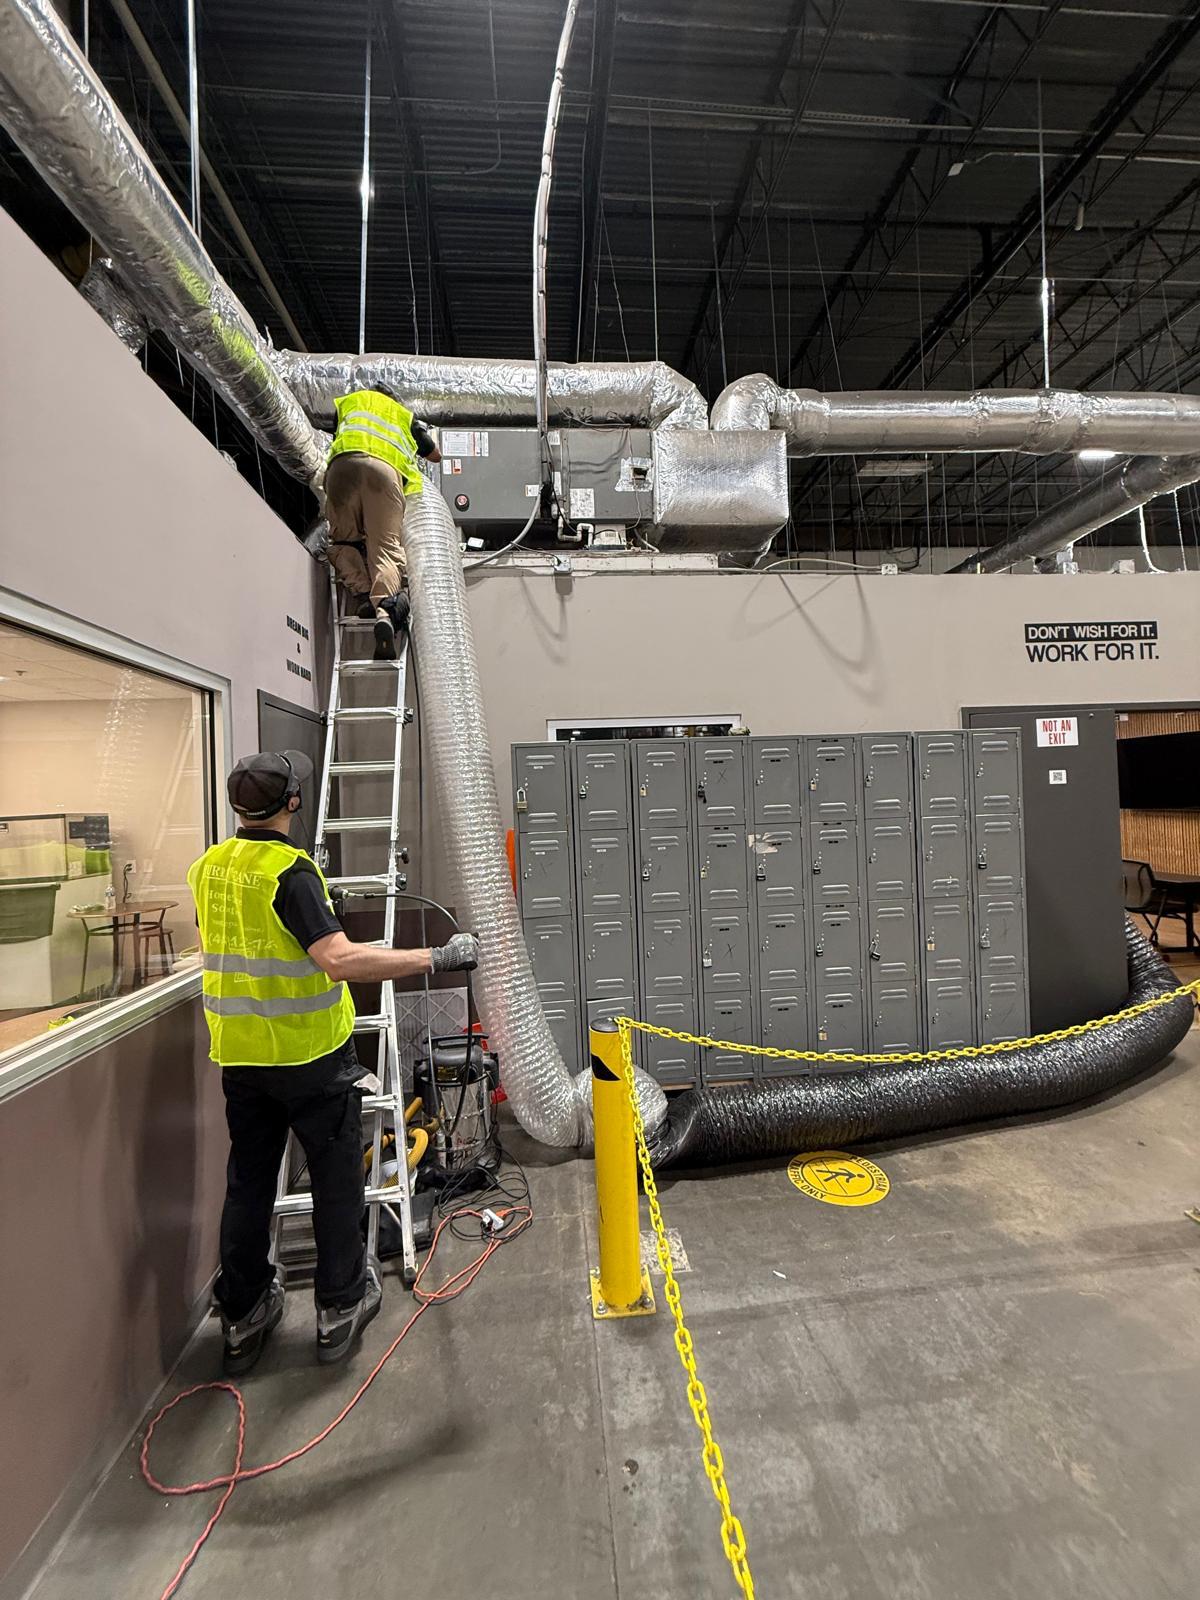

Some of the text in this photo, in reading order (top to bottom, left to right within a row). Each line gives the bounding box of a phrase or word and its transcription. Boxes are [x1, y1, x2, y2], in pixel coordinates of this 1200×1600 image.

[1028, 624, 1154, 639] DON'T WISH FOR IT.
[1026, 642, 1159, 662] WORK FOR IT.
[1042, 720, 1071, 732] NOT AN
[1048, 732, 1066, 745] EXIT
[801, 1184, 826, 1200] ONLY
